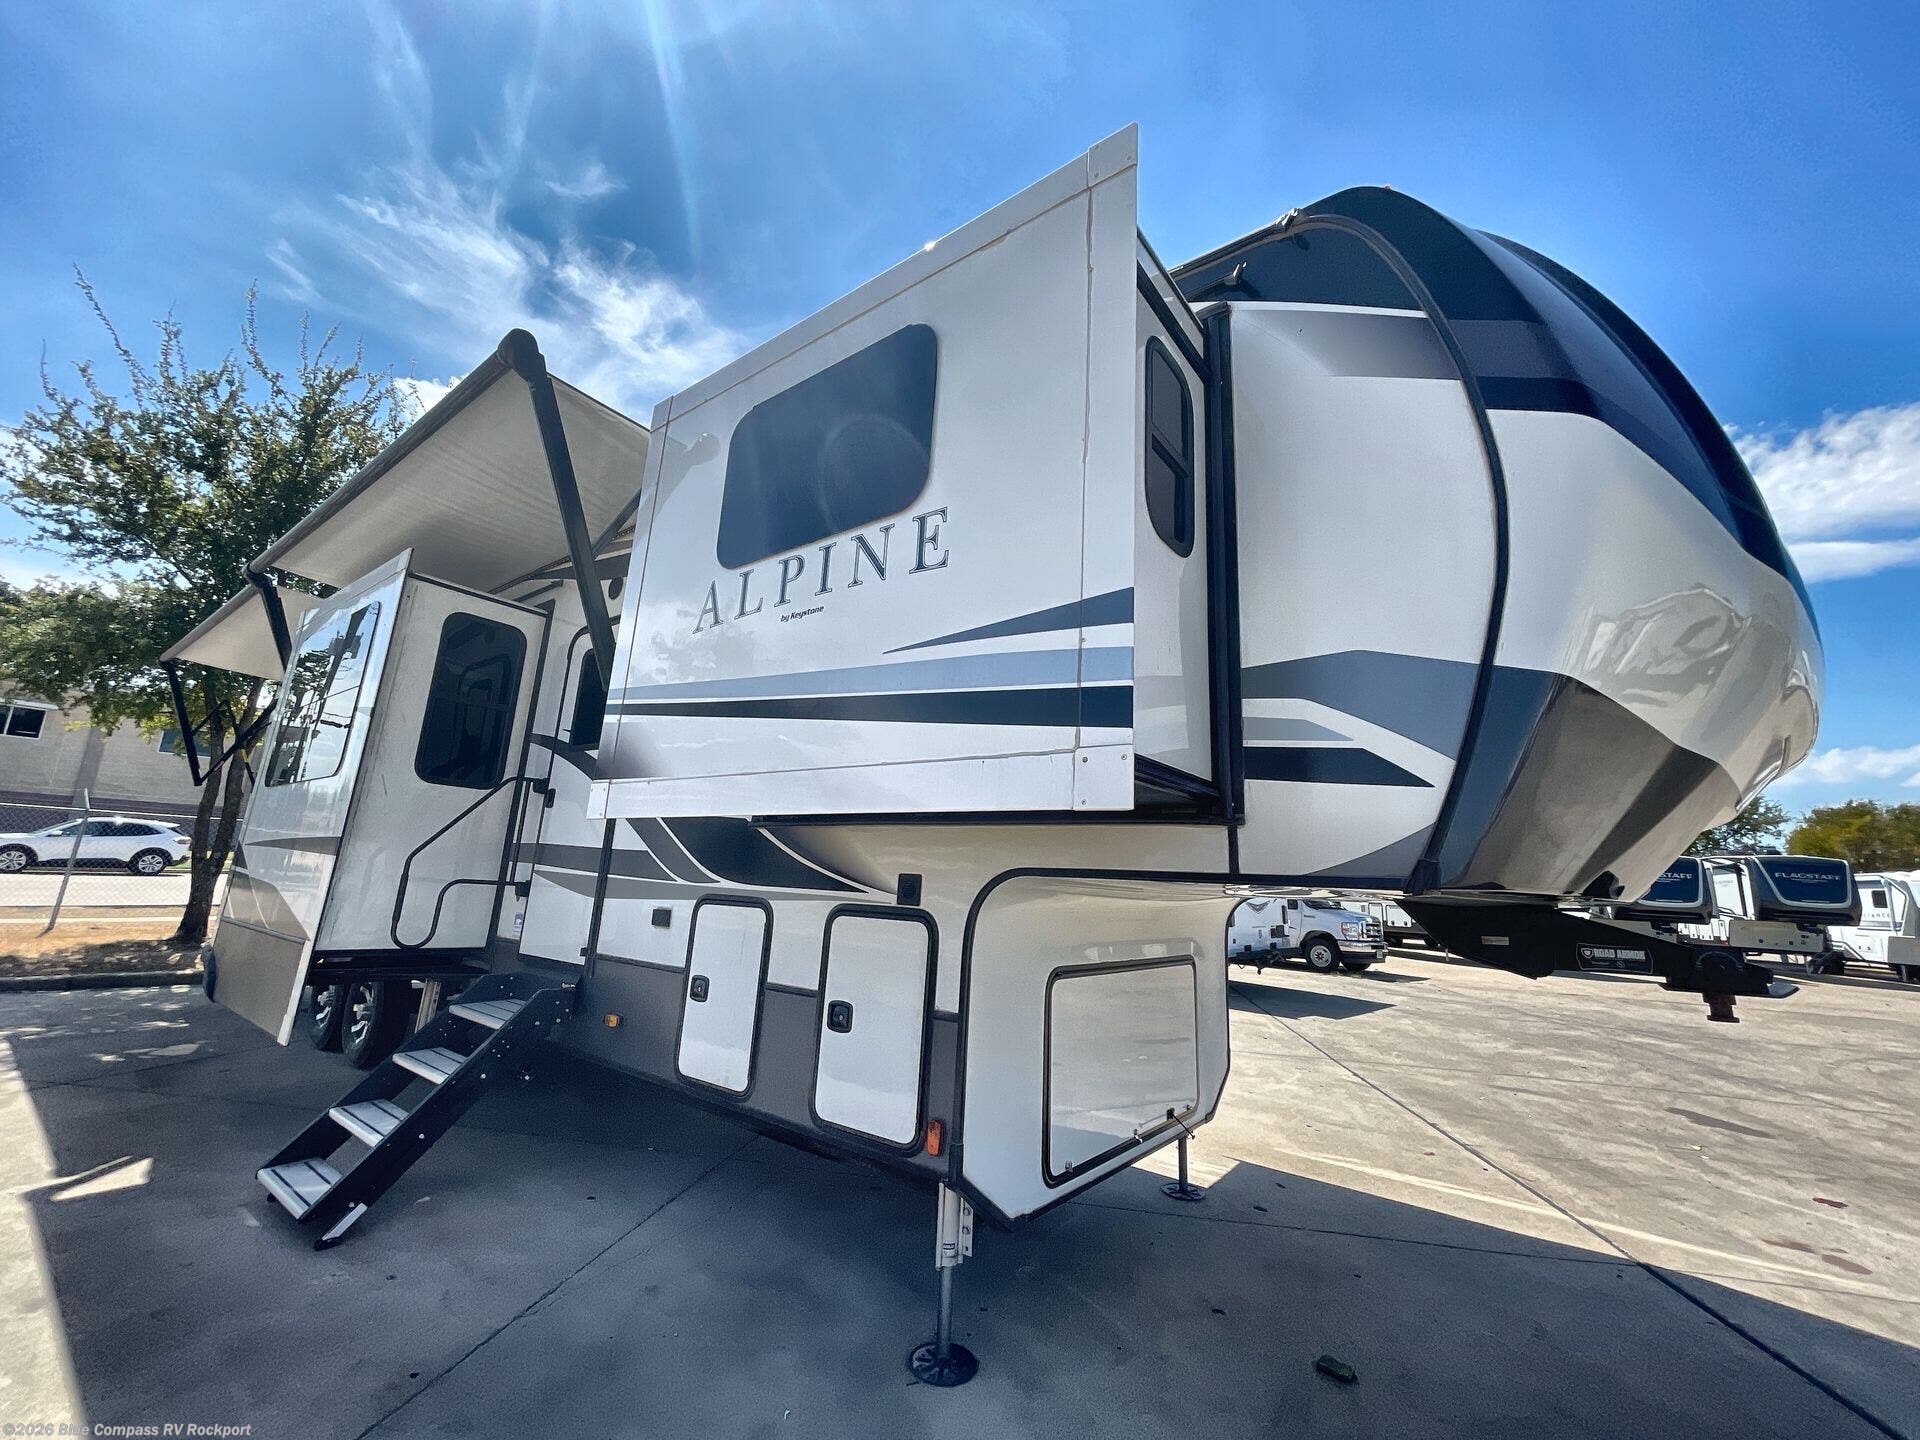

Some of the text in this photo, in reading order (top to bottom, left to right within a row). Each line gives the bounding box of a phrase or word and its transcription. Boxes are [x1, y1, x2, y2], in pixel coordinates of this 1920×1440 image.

[692, 506, 949, 634] ALPINE
[780, 605, 825, 623] by Keystone
[1774, 872, 1841, 880] FLAGSTAFF
[1594, 948, 1646, 960] ROAD ARMOR
